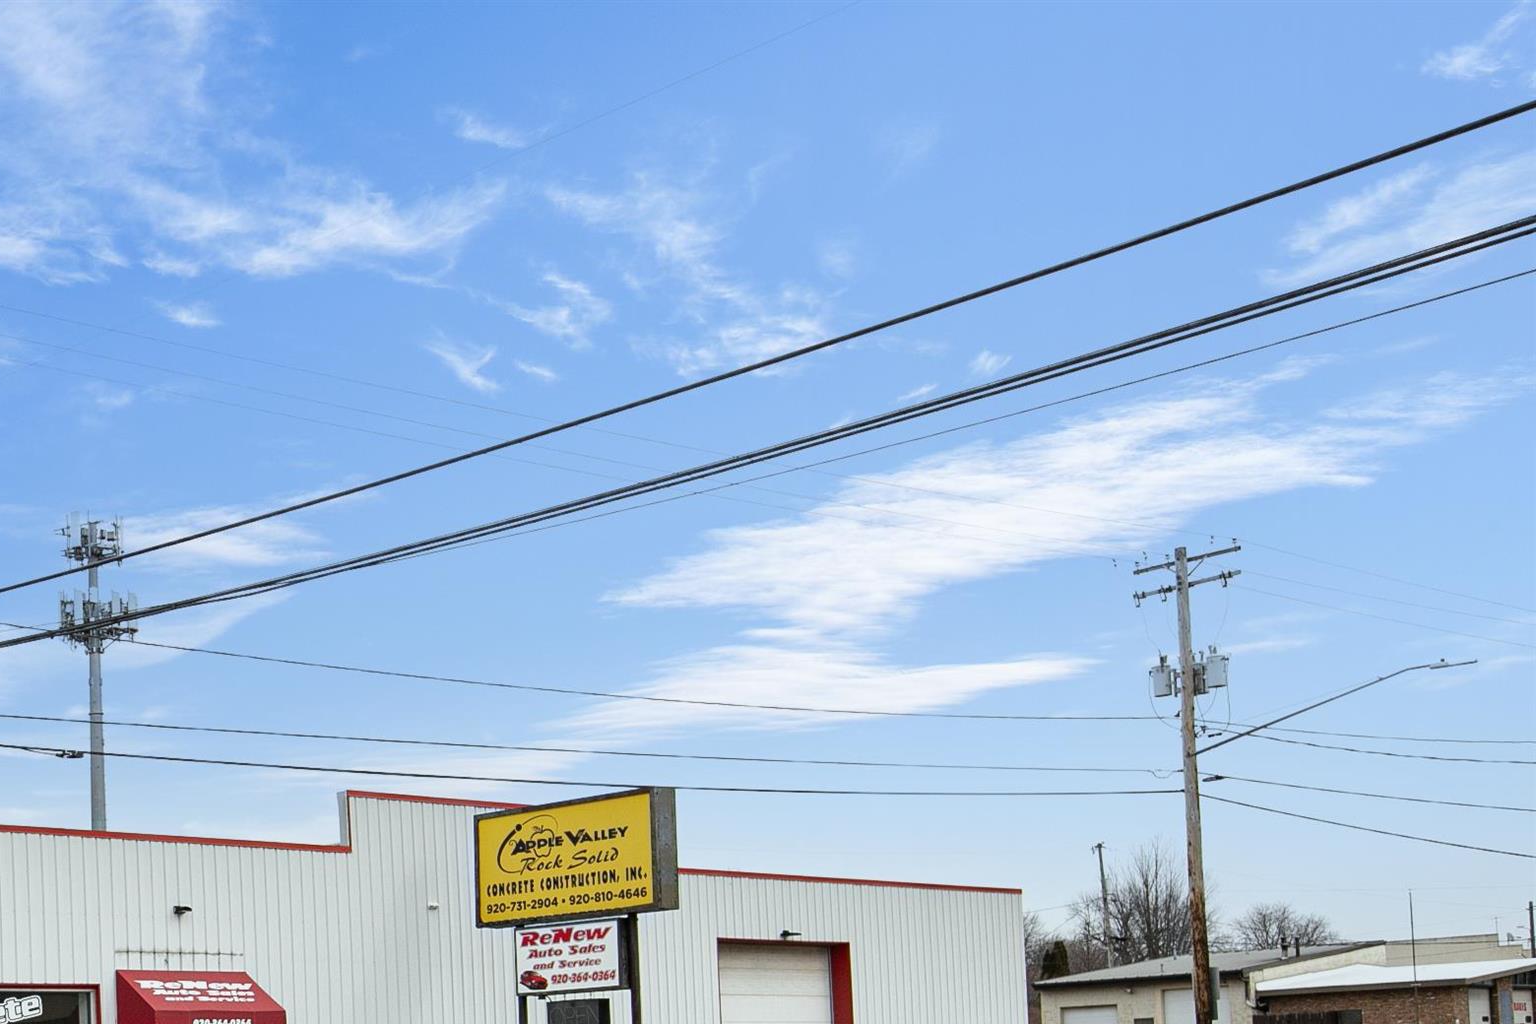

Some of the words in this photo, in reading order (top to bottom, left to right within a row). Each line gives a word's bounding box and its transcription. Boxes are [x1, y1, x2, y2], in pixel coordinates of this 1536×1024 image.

[564, 826, 629, 846] VALLEY
[520, 854, 563, 876] Rock
[567, 847, 619, 870] Solid
[486, 879, 535, 897] CONCRETE
[540, 868, 620, 891] CONSTRUCTION,
[625, 866, 648, 881] INC.
[486, 897, 559, 914] 920-731-2904
[568, 886, 648, 906] 920-810-4646
[519, 926, 612, 948] ReNew
[527, 949, 563, 960] Auto
[568, 944, 606, 956] Sales
[533, 960, 554, 971] and
[558, 957, 602, 969] Service
[551, 969, 617, 985] 920-364-0364
